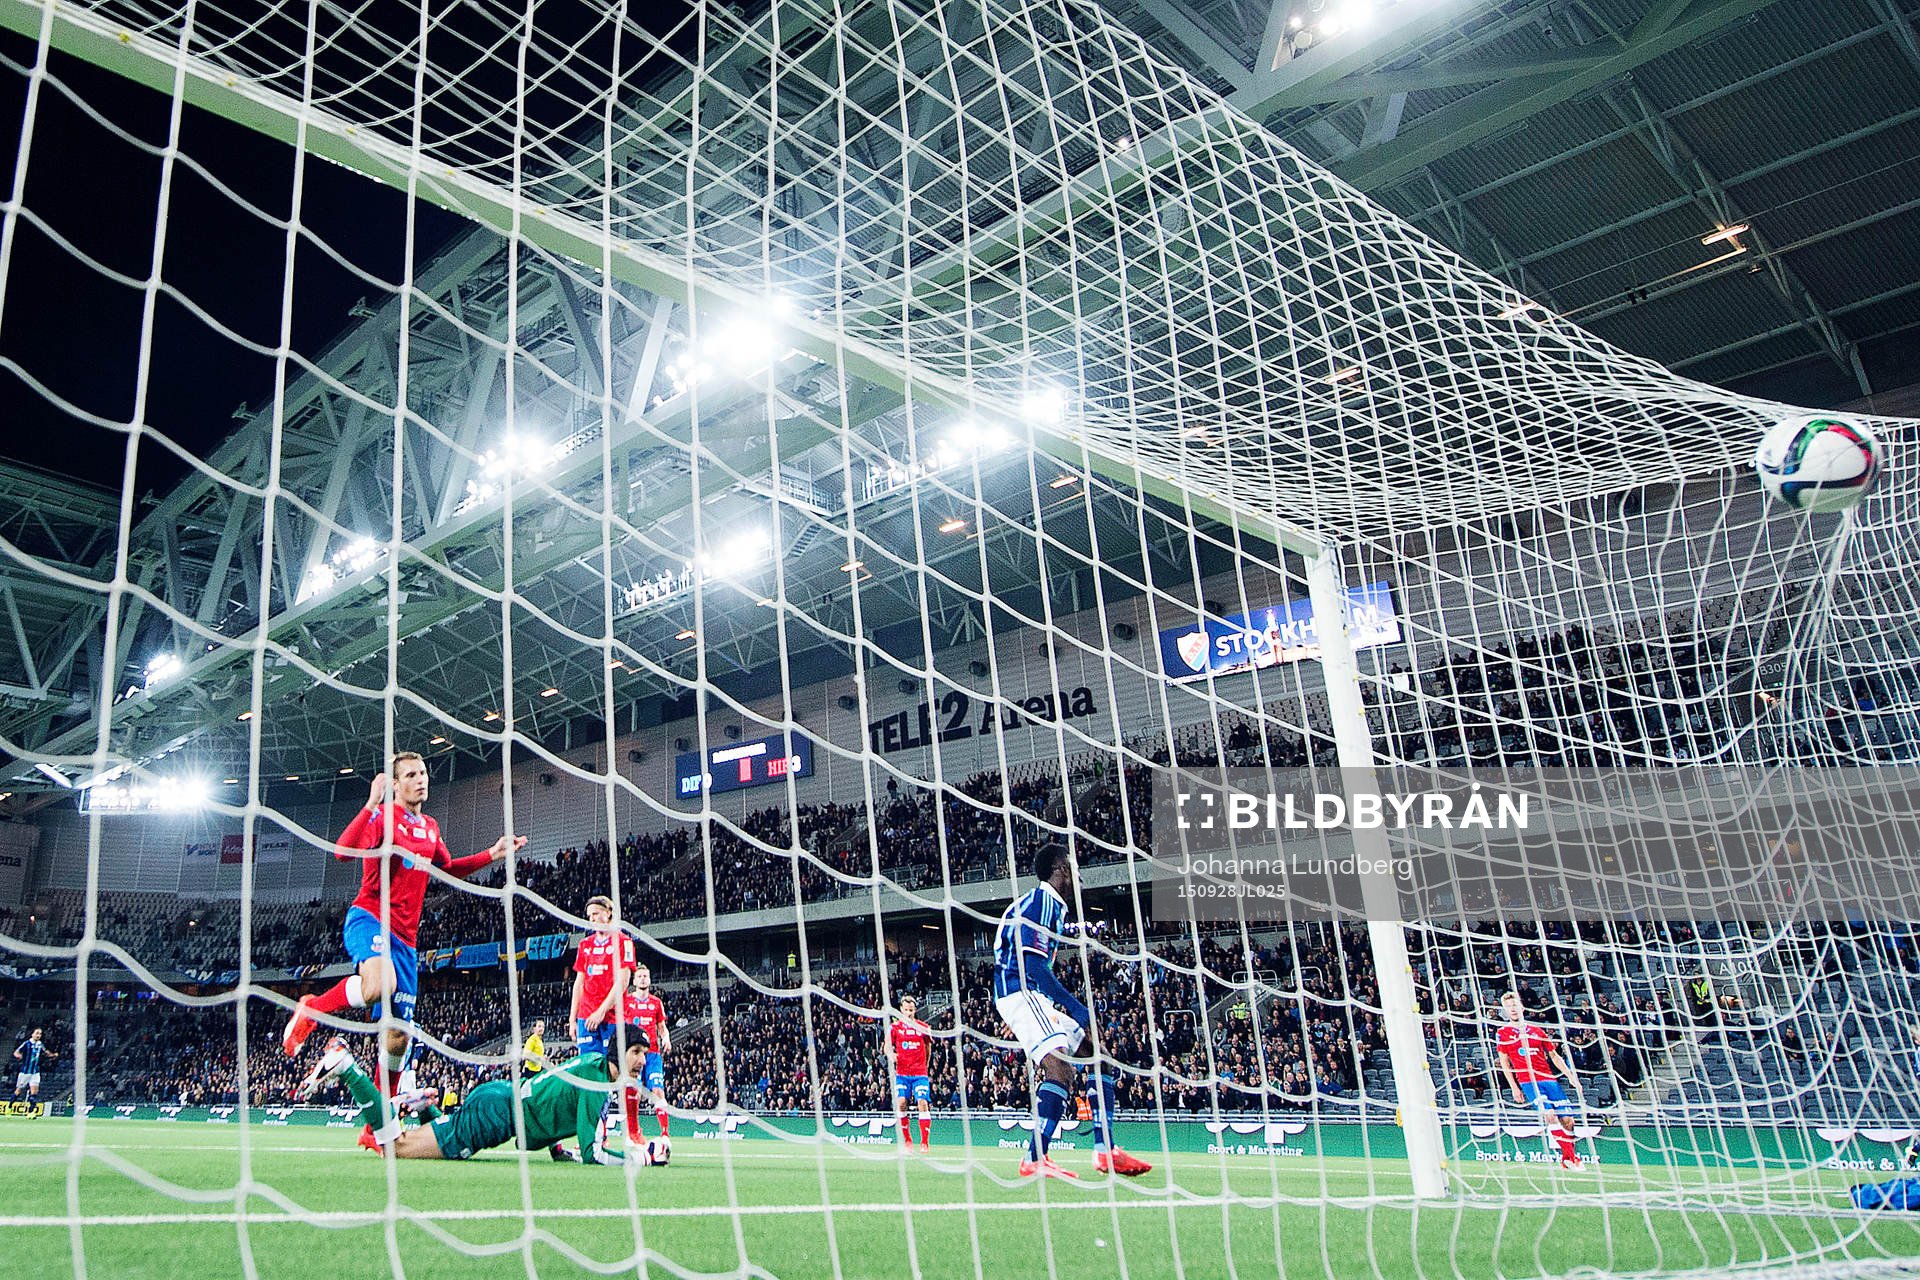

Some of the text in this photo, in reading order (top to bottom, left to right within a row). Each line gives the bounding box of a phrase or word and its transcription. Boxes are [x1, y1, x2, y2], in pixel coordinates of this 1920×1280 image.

[1216, 604, 1378, 657] STOCKHM
[868, 687, 1097, 754] TELE2 Arena
[1207, 1144, 1304, 1157] Sport & Marketing
[1475, 1150, 1601, 1164] Sport & Marking
[1828, 1157, 1875, 1171] Sport
[1880, 1158, 1895, 1171] &
